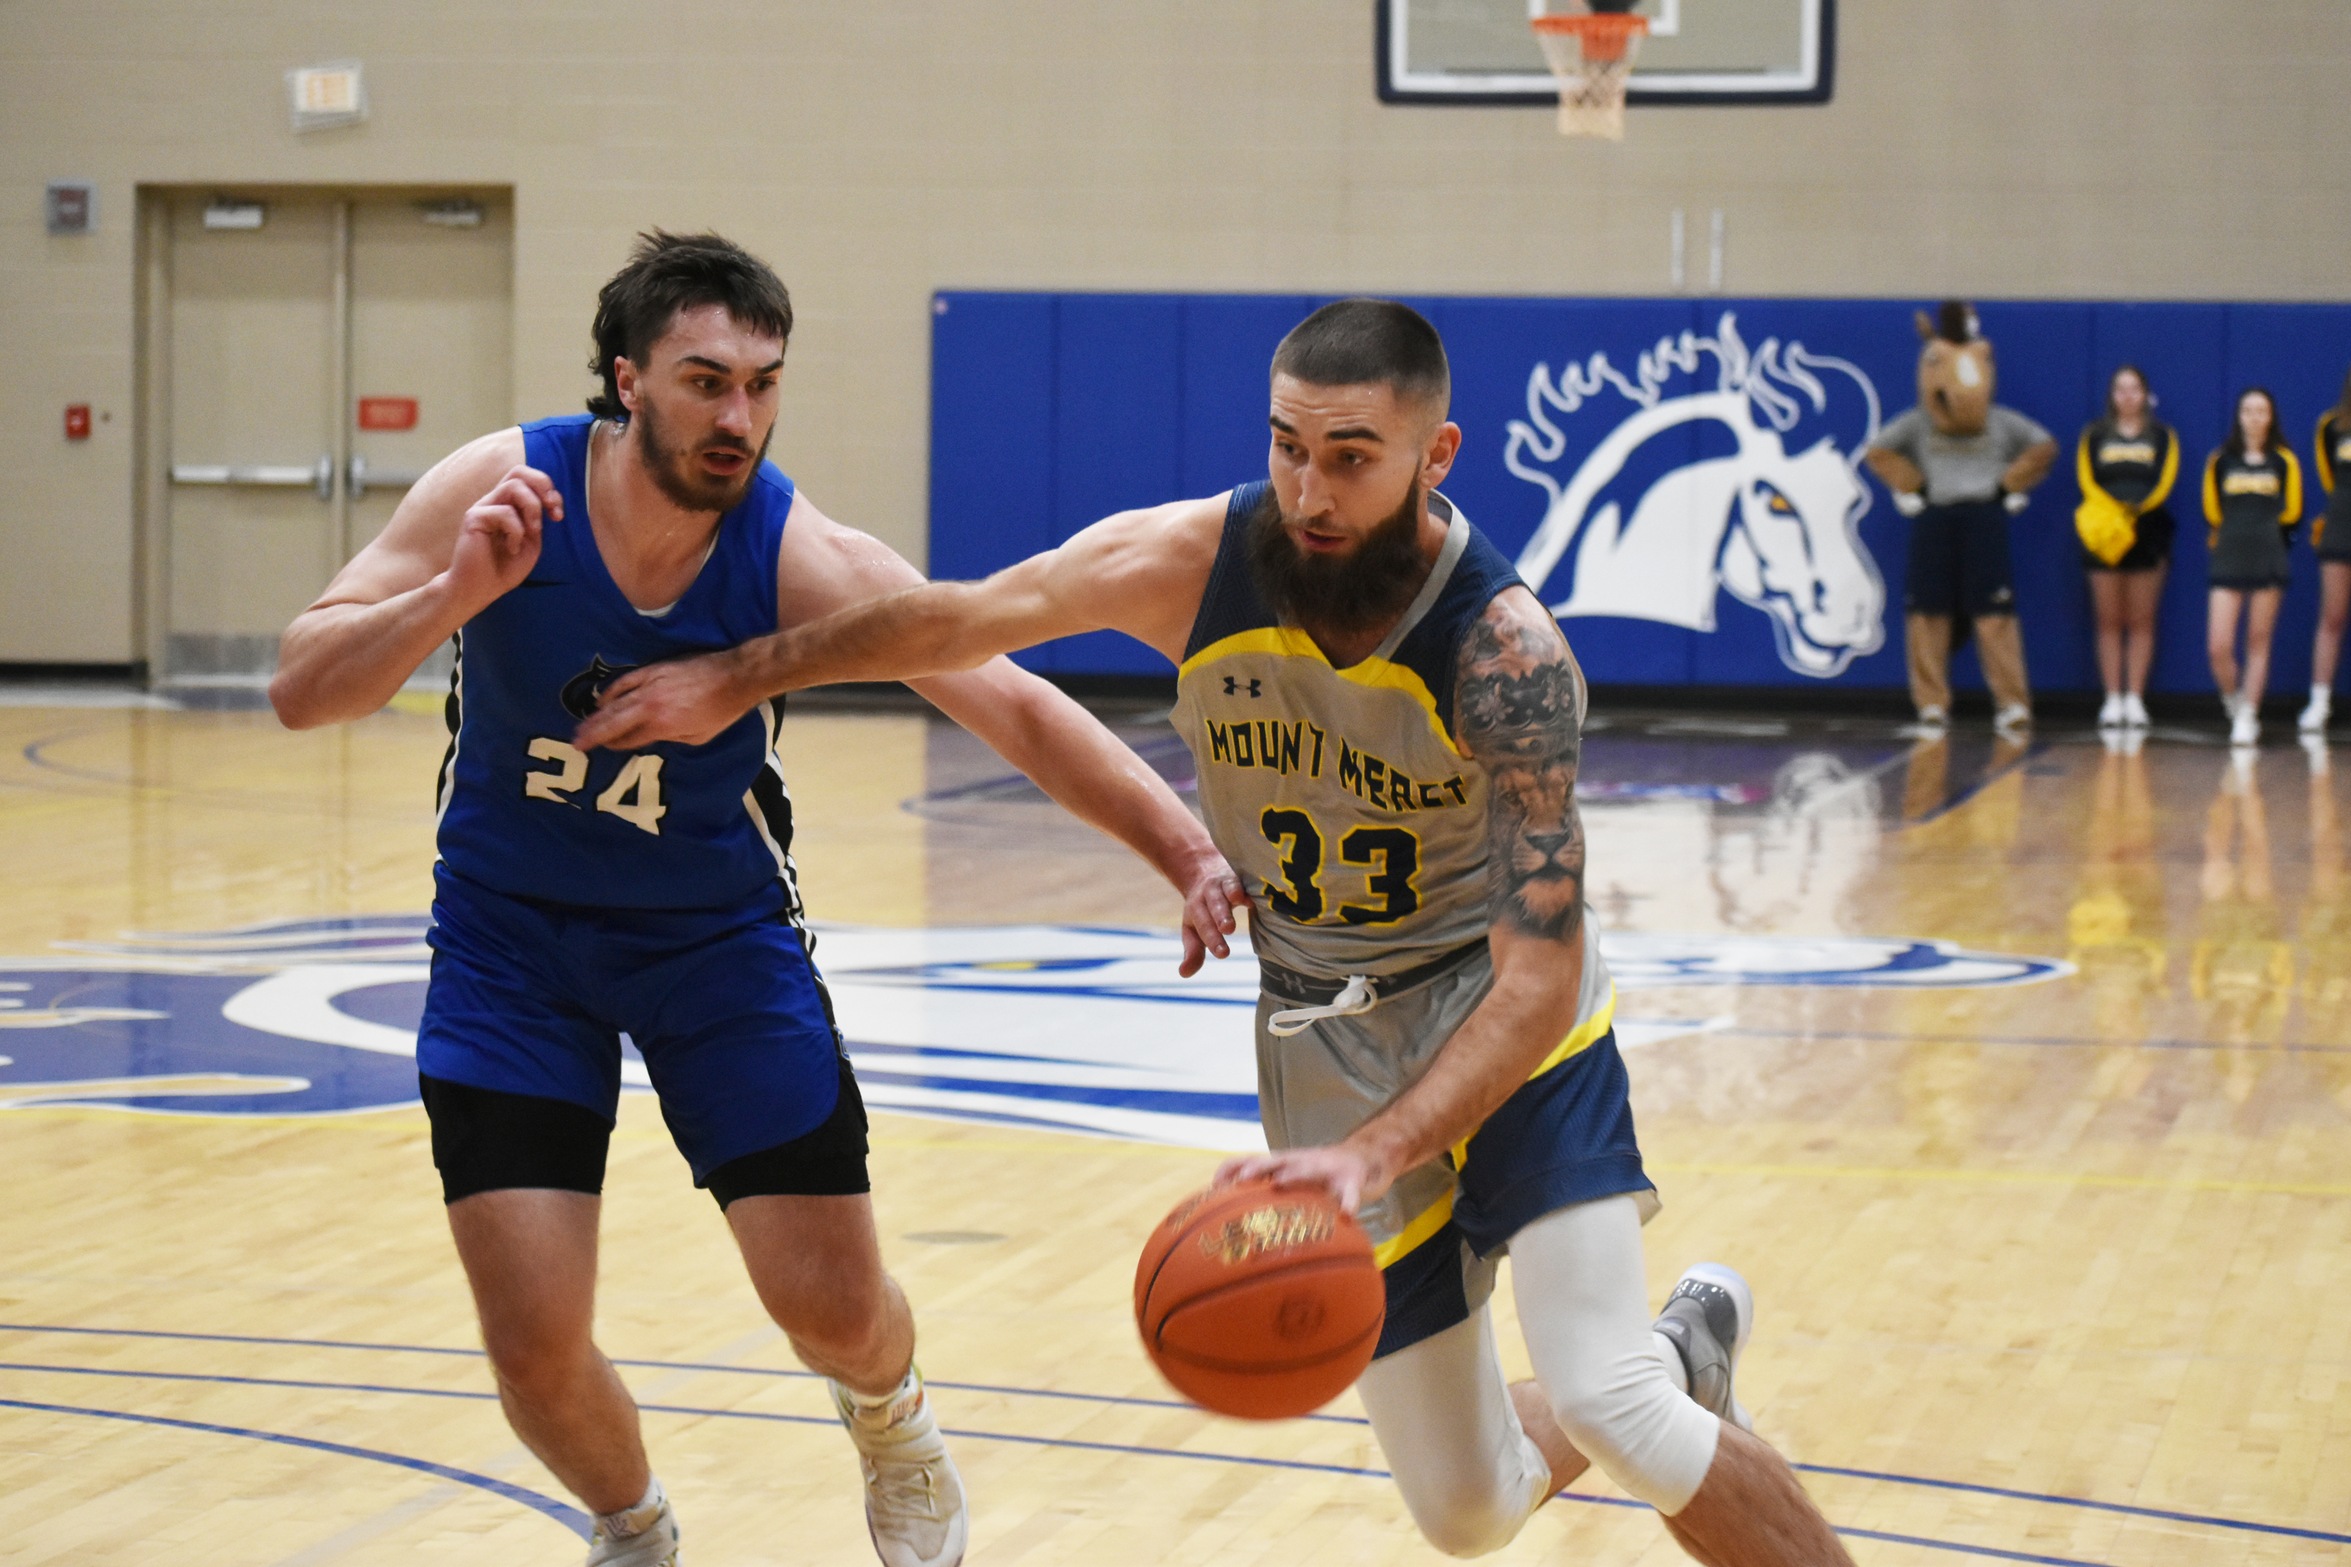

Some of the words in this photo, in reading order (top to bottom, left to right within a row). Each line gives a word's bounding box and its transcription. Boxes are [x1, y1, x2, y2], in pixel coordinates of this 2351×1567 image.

[523, 735, 670, 836] 24
[1205, 719, 1326, 779] MOUNT
[1260, 804, 1423, 927] 33
